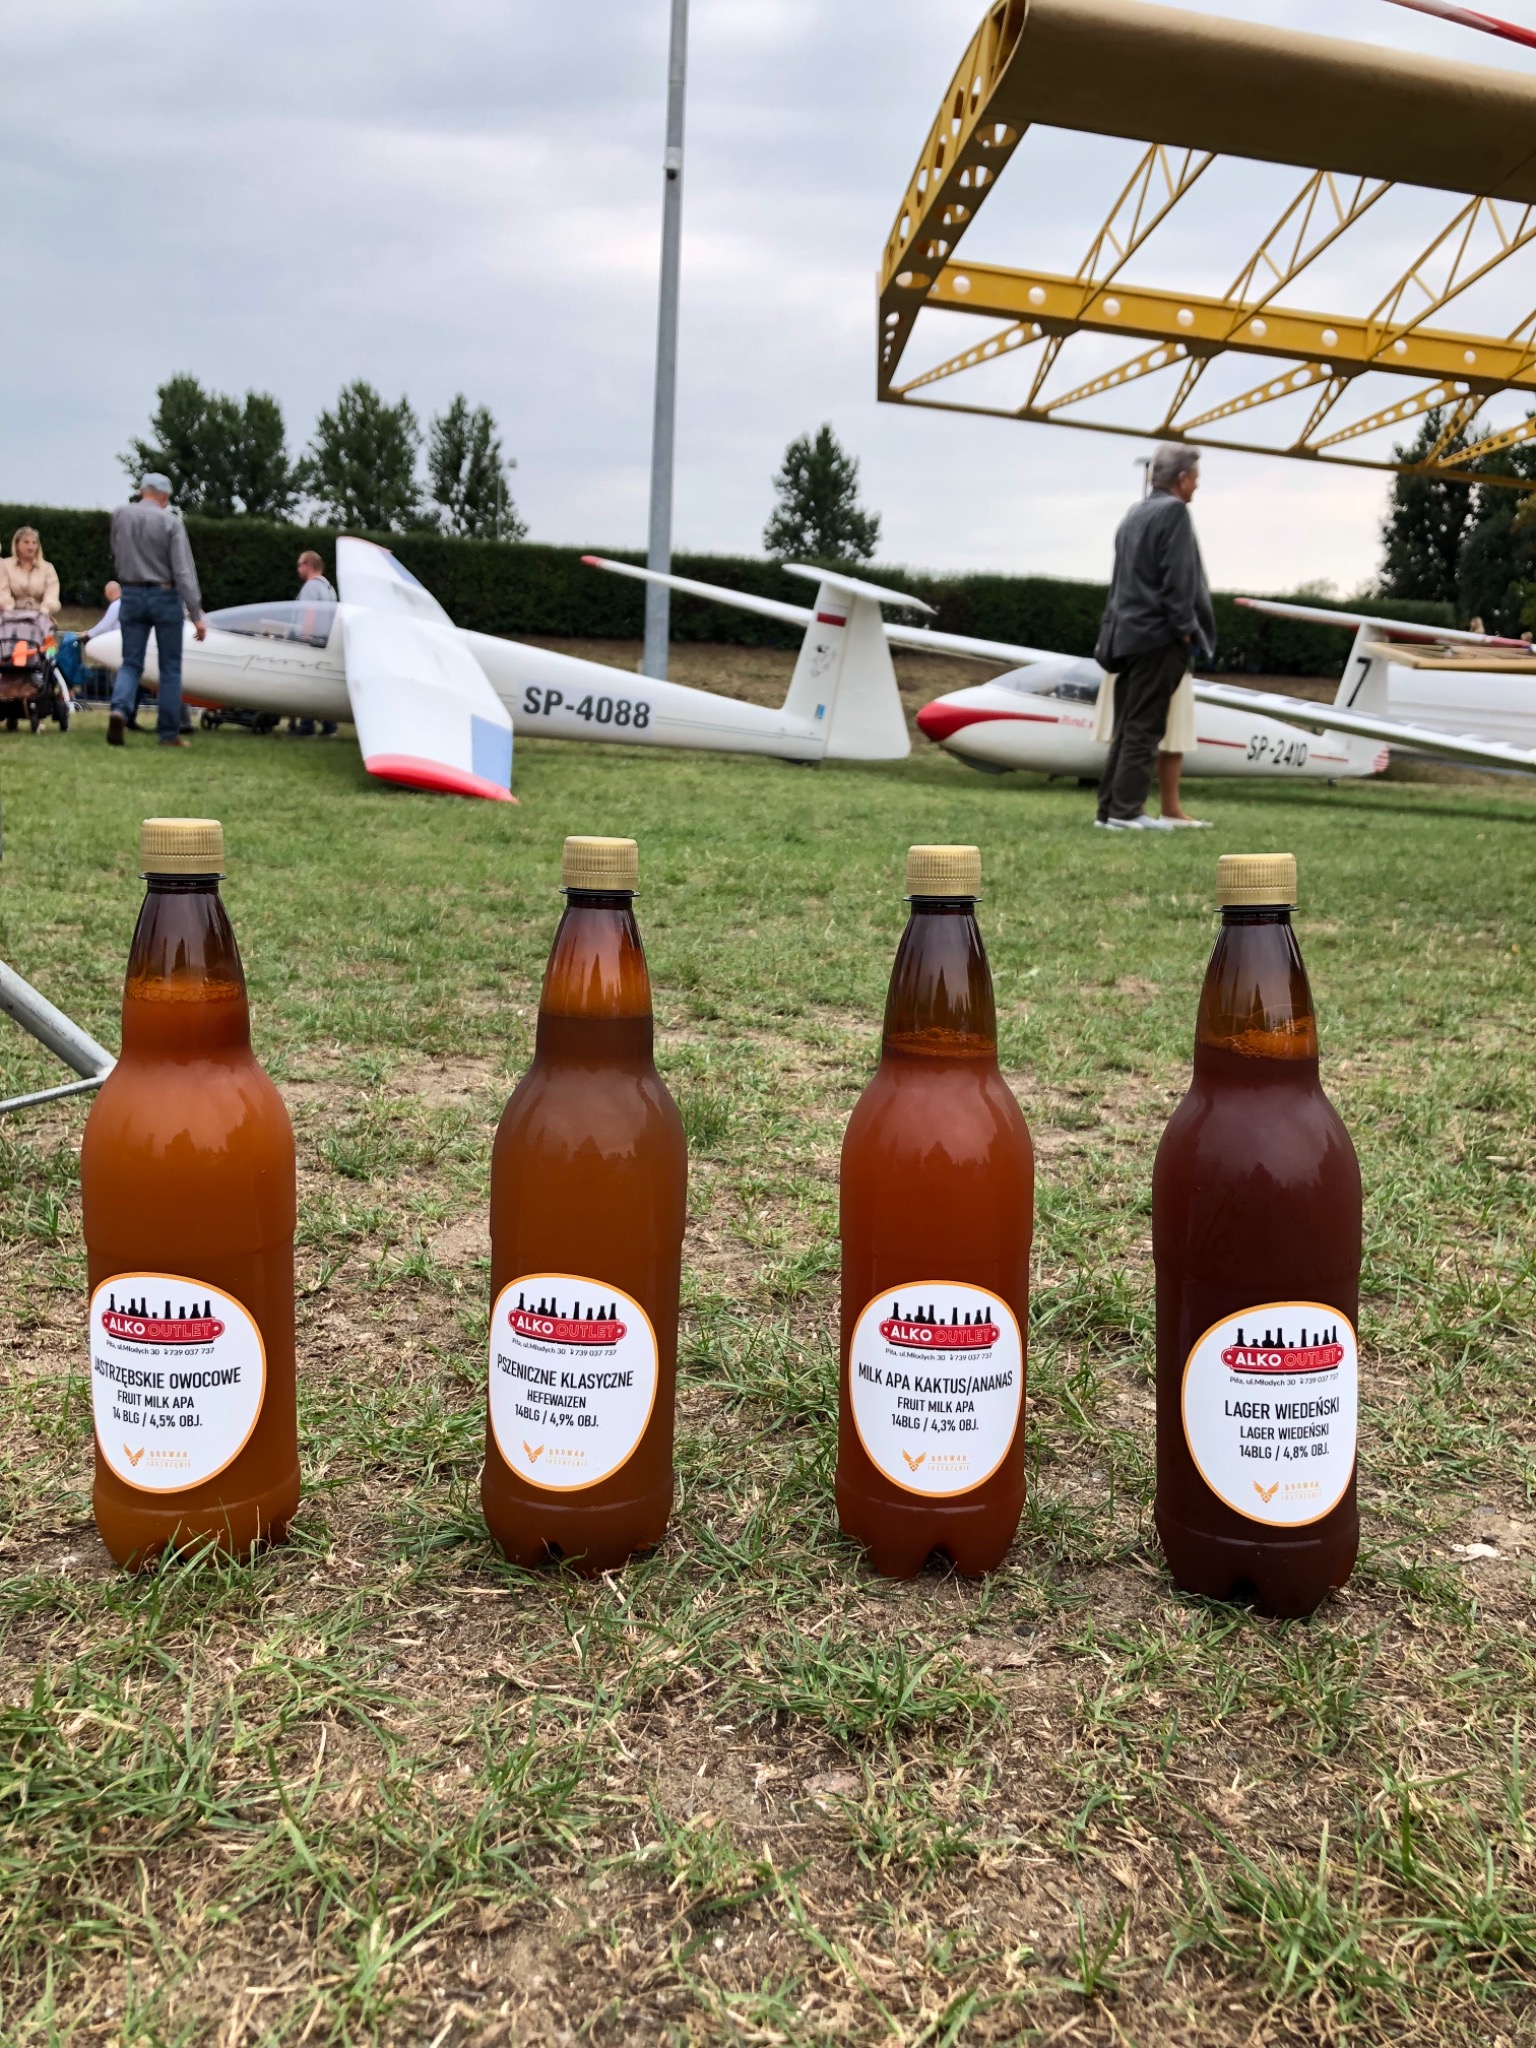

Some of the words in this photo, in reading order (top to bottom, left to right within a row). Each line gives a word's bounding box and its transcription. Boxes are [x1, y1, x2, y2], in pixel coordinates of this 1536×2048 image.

[1347, 656, 1373, 708] 7
[523, 686, 650, 728] SP-4088
[1247, 734, 1308, 767] SP-2410
[109, 1317, 145, 1335] ALKO
[148, 1322, 211, 1338] OUTLET
[516, 1315, 554, 1335] ALKO
[556, 1323, 616, 1338] OUTLET
[890, 1324, 933, 1342] ALKO
[934, 1329, 990, 1343] OUTLET
[1235, 1351, 1282, 1367] ALKO
[1284, 1347, 1337, 1367] OUTLET
[169, 1366, 242, 1390] OWOCOWE
[497, 1353, 557, 1387] PSZENICZNE
[561, 1370, 634, 1389] KLASYCZNE
[858, 1362, 882, 1384] MILK
[886, 1371, 910, 1391] APA
[914, 1370, 1013, 1396] KAKTUS/ANANAS
[1317, 1375, 1329, 1383] 037
[117, 1390, 142, 1407] FRUIT
[144, 1395, 170, 1409] MILK
[172, 1396, 195, 1409] APA
[527, 1389, 587, 1409] HEFEWAIZEN
[897, 1396, 926, 1412] FRUIT
[928, 1400, 953, 1413] MILK
[955, 1400, 975, 1413] APA
[1225, 1399, 1270, 1420] LAGER
[1275, 1396, 1340, 1420] WIEDEŃSKI
[112, 1406, 121, 1420] 14
[123, 1410, 140, 1424] BLG
[142, 1412, 147, 1428] /
[150, 1414, 176, 1429] 4,5%
[179, 1414, 203, 1427] OBJ.
[515, 1404, 540, 1422] 14BLG
[542, 1410, 548, 1425] /
[549, 1413, 574, 1427] 4,9%
[577, 1415, 599, 1427] OBJ.
[891, 1414, 921, 1430] 14BLG
[923, 1417, 928, 1432] /
[931, 1419, 956, 1433] 4,3%
[959, 1418, 979, 1431] OBJ.
[1240, 1425, 1275, 1440] LAGER
[1278, 1422, 1330, 1440] WIEDEŃSKI
[1239, 1444, 1272, 1459] 14BLG
[1275, 1445, 1280, 1461] /
[1283, 1446, 1308, 1461] 4,8%
[1311, 1442, 1330, 1457] OBJ.
